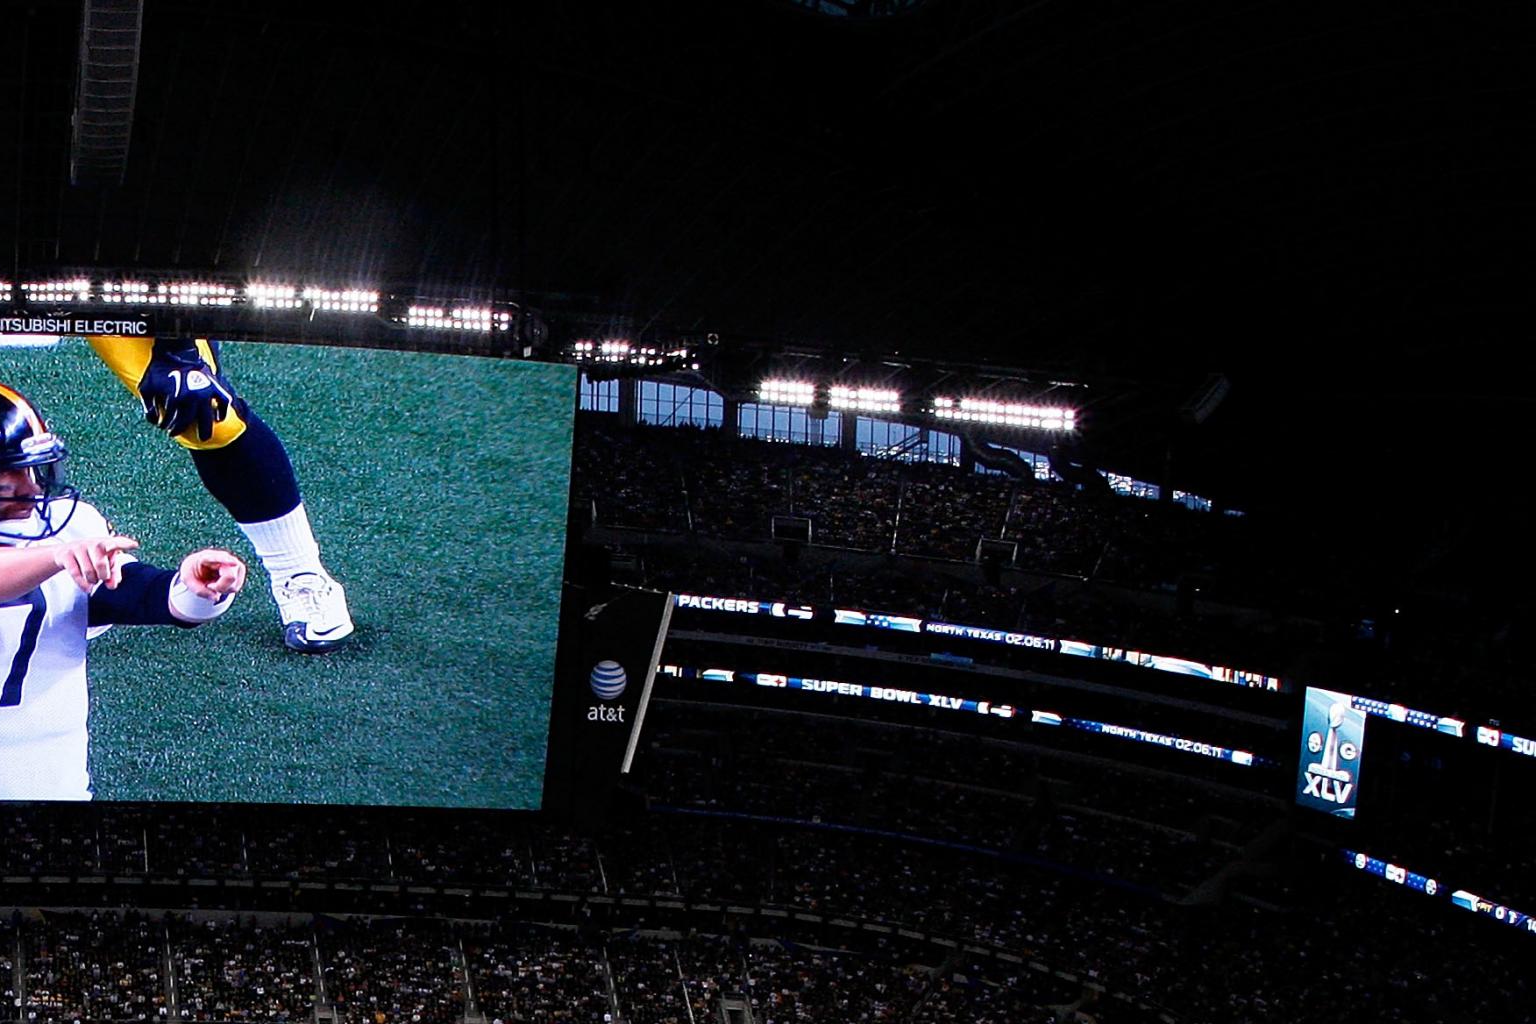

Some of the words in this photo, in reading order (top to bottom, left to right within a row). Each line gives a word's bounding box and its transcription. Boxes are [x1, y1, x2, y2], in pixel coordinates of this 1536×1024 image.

[75, 319, 148, 335] ELECTRIC
[678, 594, 759, 614] PACKERS
[926, 623, 963, 637] NORTH
[967, 628, 1002, 642] TEXAS
[1005, 633, 1056, 651] 02.06.11
[801, 678, 863, 697] SUPER
[870, 686, 922, 705] BOWL
[928, 693, 963, 711] XLV
[587, 703, 626, 723] at&t
[1101, 723, 1137, 740] NORTH
[1140, 729, 1173, 747] TEXAS
[1175, 737, 1224, 759] 02.06.11
[1302, 771, 1354, 804] XLV
